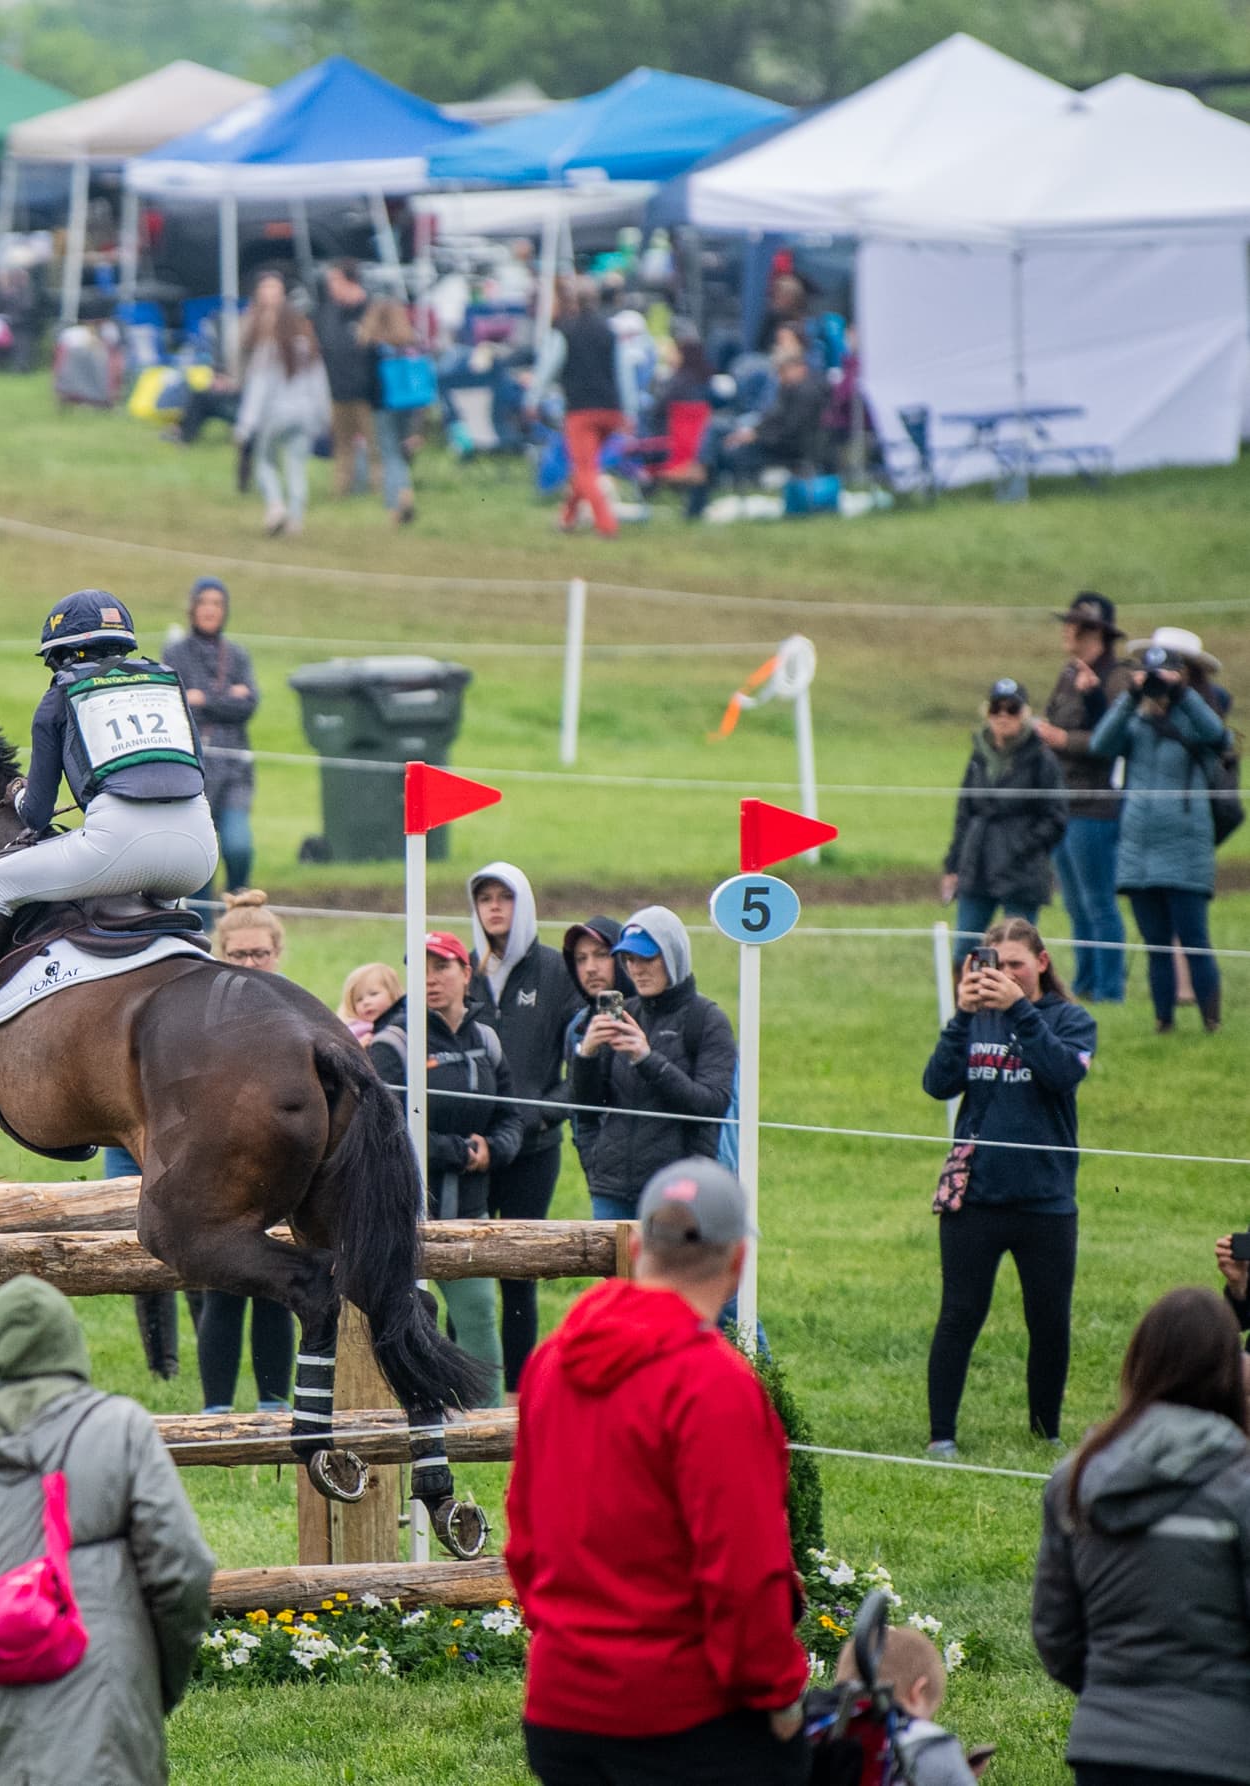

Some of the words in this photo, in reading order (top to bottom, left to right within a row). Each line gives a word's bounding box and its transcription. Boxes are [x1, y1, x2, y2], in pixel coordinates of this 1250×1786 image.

[105, 712, 168, 740] 112
[111, 736, 172, 753] BRANNIGAN
[741, 886, 771, 932] 5
